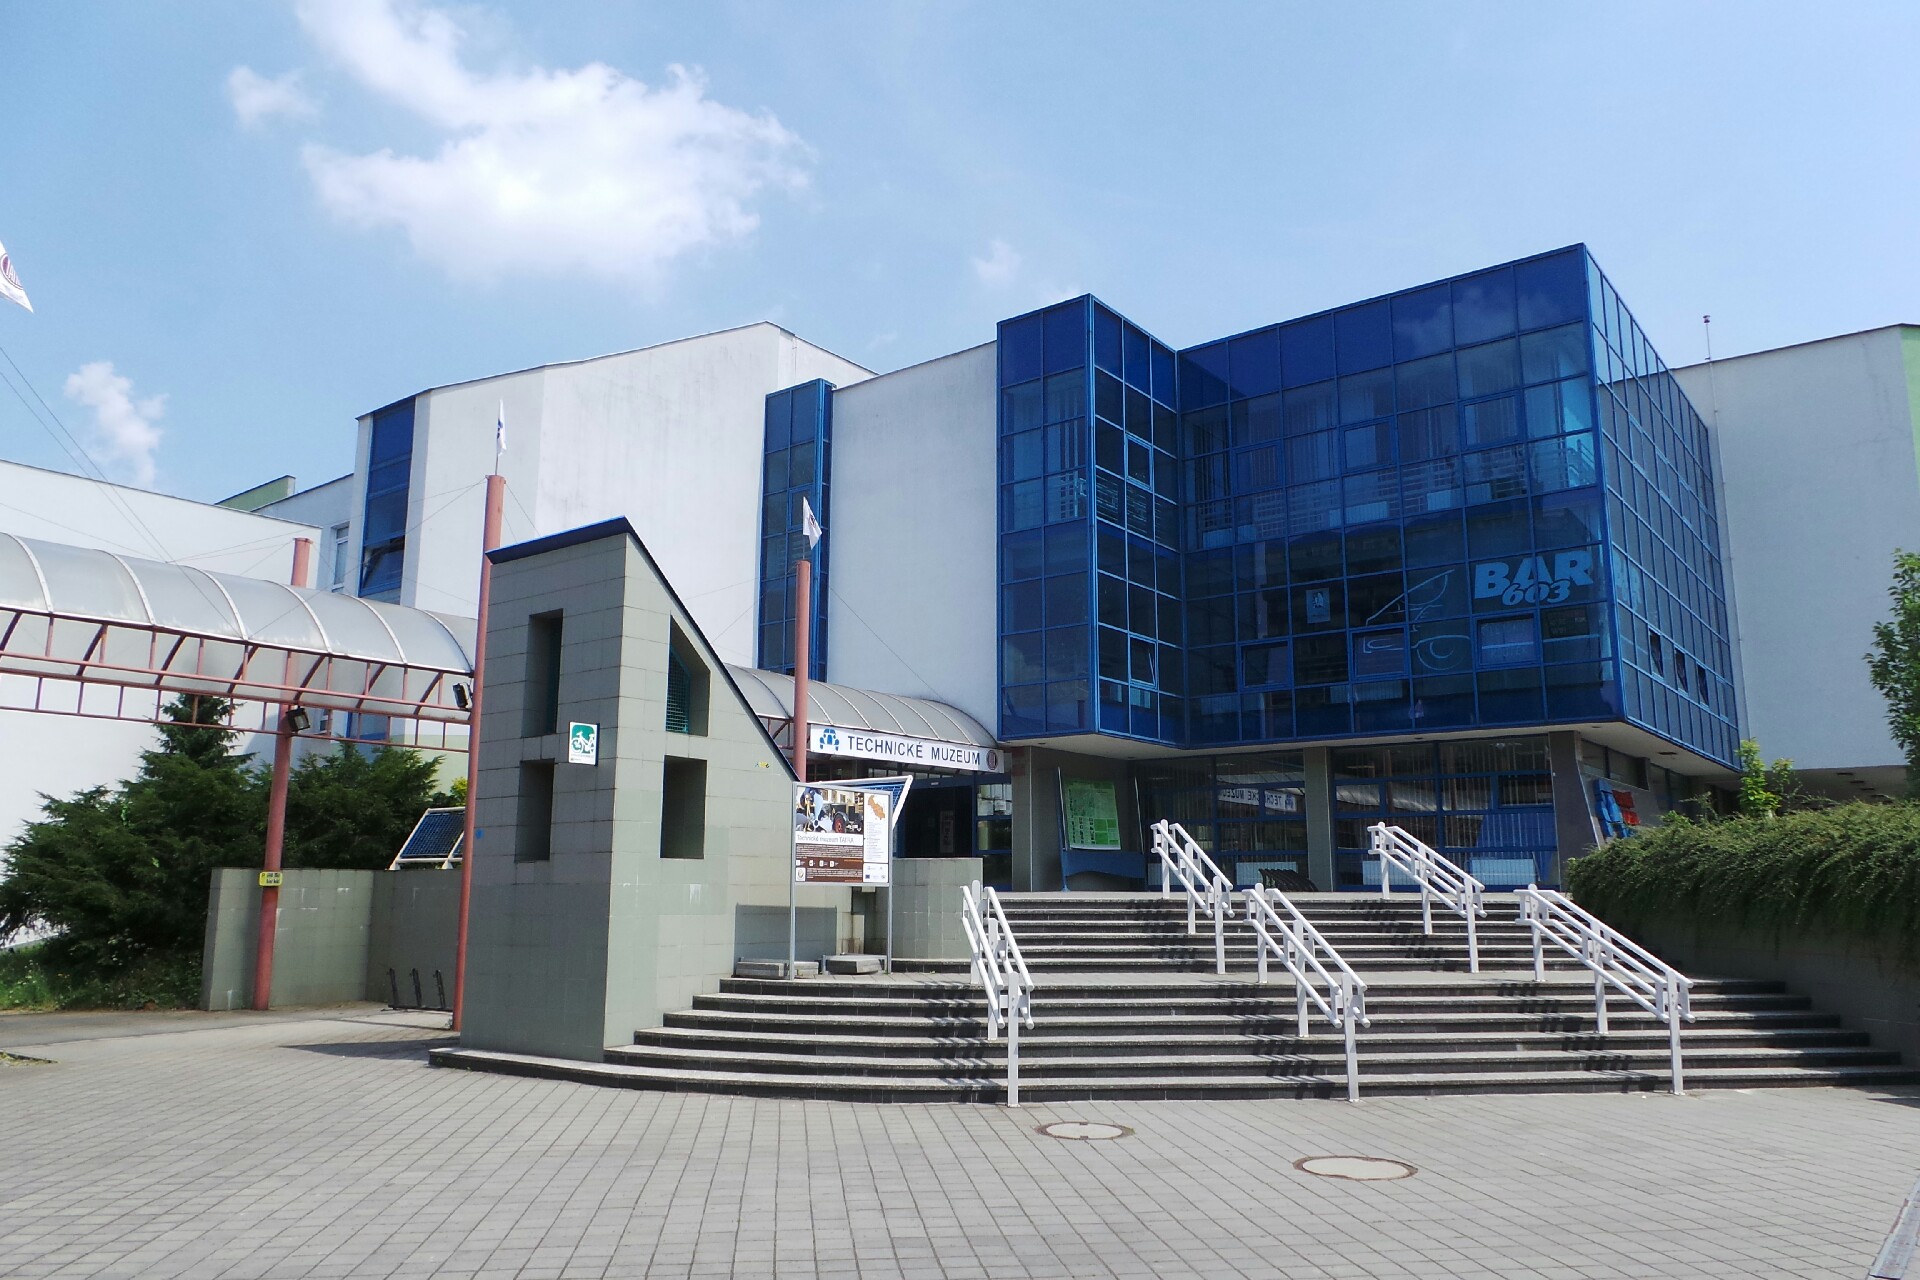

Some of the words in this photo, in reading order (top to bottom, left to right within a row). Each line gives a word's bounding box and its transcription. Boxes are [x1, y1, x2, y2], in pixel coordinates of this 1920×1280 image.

[1475, 550, 1594, 599] BAR
[1501, 579, 1571, 606] 603
[848, 735, 923, 759] TECHNICKÉ
[931, 746, 981, 766] MUZEUM
